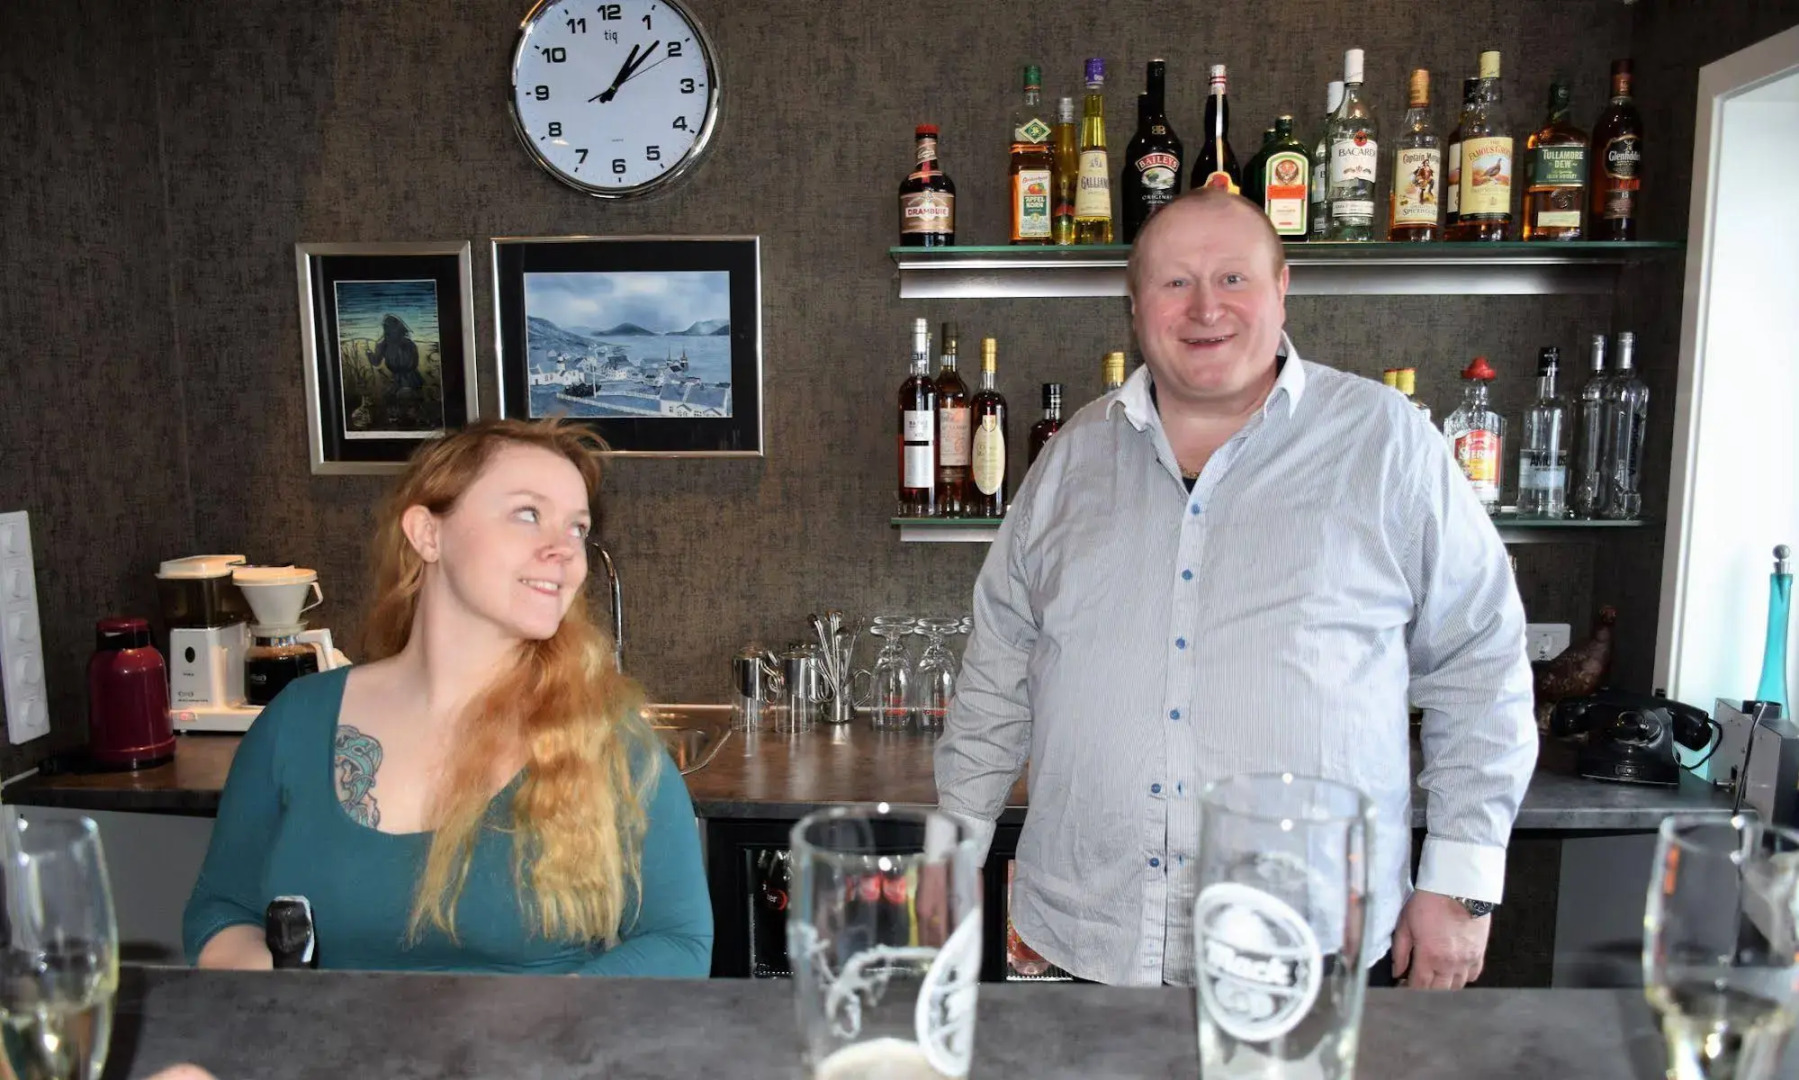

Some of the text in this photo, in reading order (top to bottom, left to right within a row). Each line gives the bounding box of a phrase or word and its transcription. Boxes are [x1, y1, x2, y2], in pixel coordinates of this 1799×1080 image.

[597, 4, 622, 20] 12
[566, 18, 587, 34] 11
[642, 15, 651, 30] 1
[604, 30, 618, 44] tiq
[541, 47, 567, 63] 10
[667, 41, 682, 57] 2
[535, 85, 549, 101] 9
[680, 78, 695, 94] 3
[548, 122, 562, 137] 8
[672, 116, 688, 131] 4
[575, 149, 589, 164] 7
[646, 145, 661, 161] 5
[1403, 153, 1425, 164] Captain
[1542, 149, 1584, 160] TULLAMORE
[612, 158, 626, 174] 6
[1139, 154, 1178, 168] BAILEYS
[1554, 160, 1571, 168] DEW
[907, 208, 947, 216] DRAMBUIE
